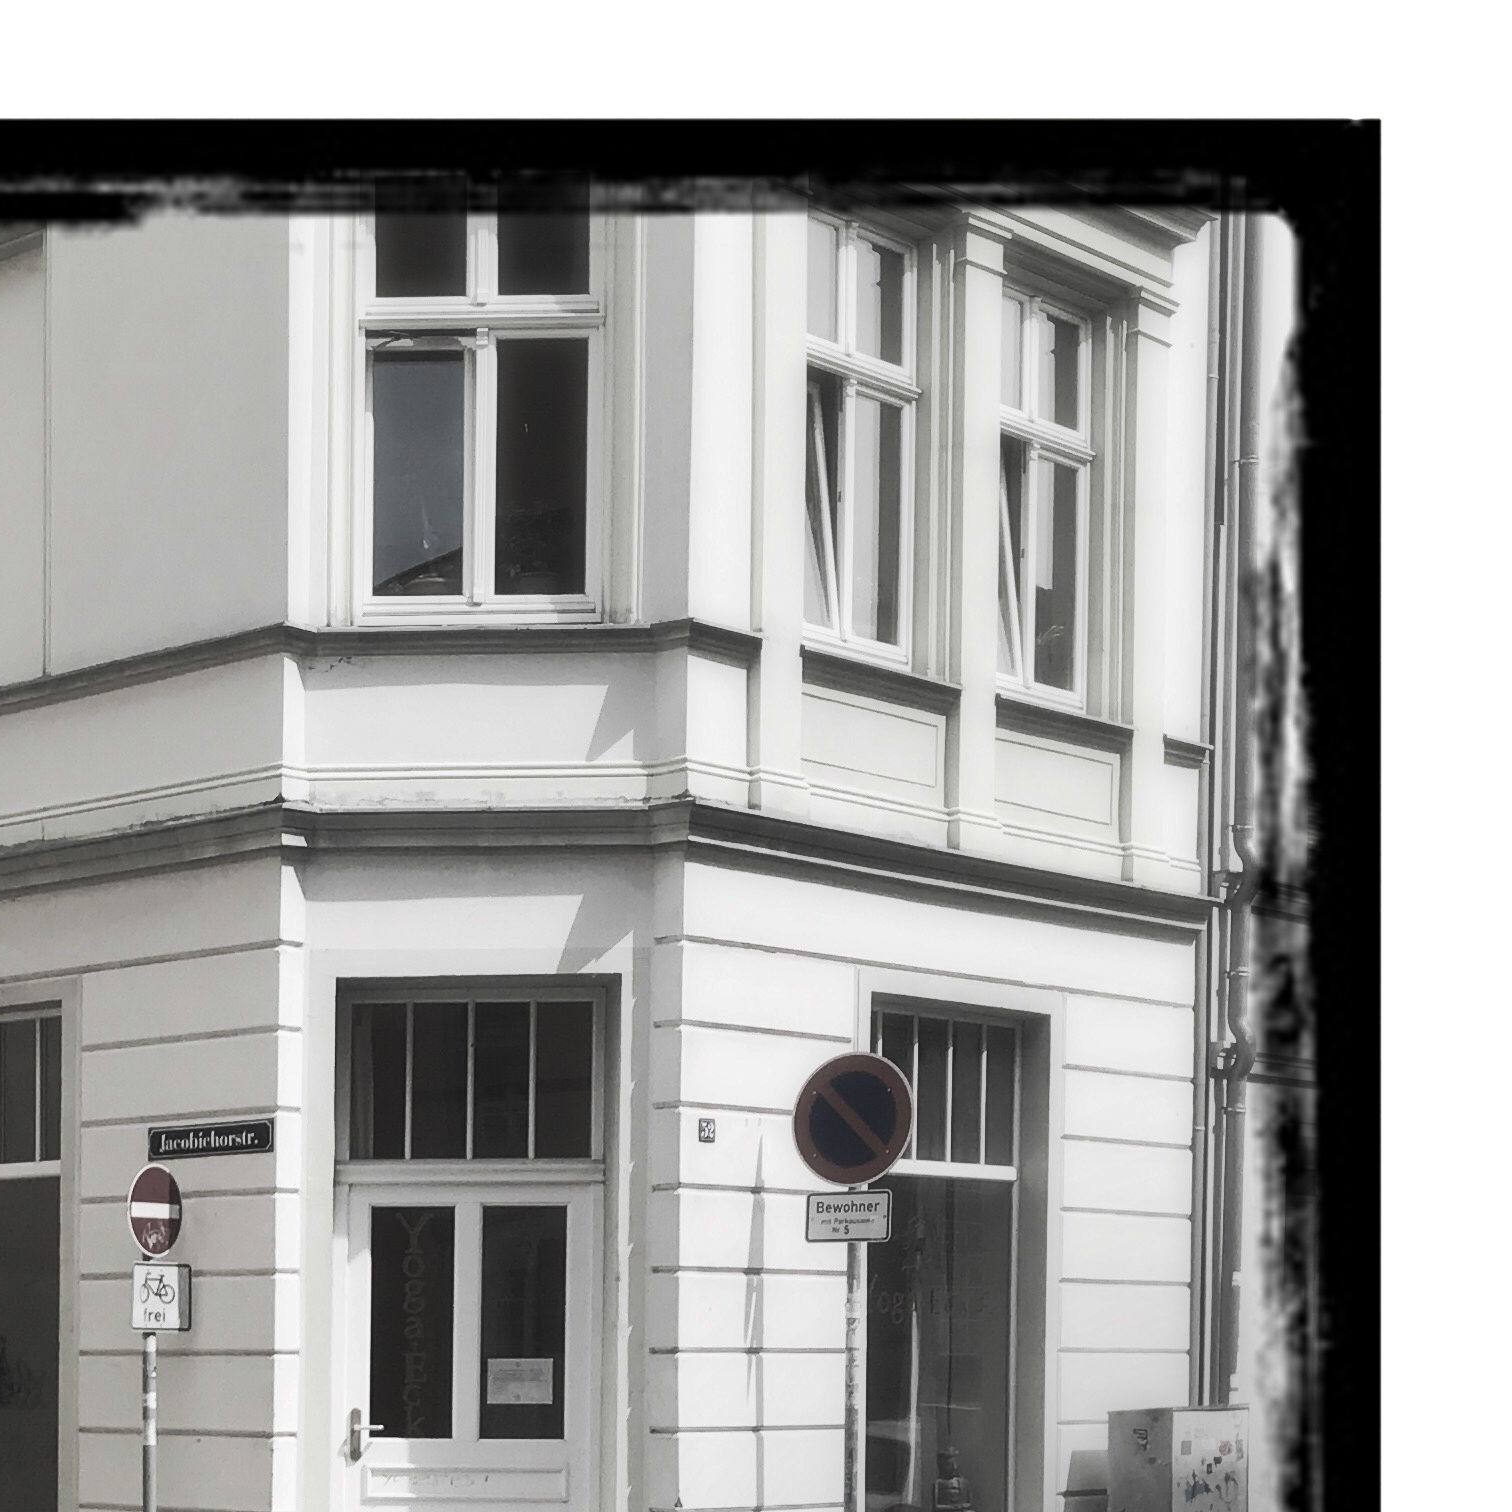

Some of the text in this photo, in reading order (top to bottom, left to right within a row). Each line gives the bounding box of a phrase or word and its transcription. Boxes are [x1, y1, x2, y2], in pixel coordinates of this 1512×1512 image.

[159, 1129, 259, 1153] Jacobichorstr.
[816, 1200, 880, 1214] Bewohner
[144, 1307, 165, 1322] frei
